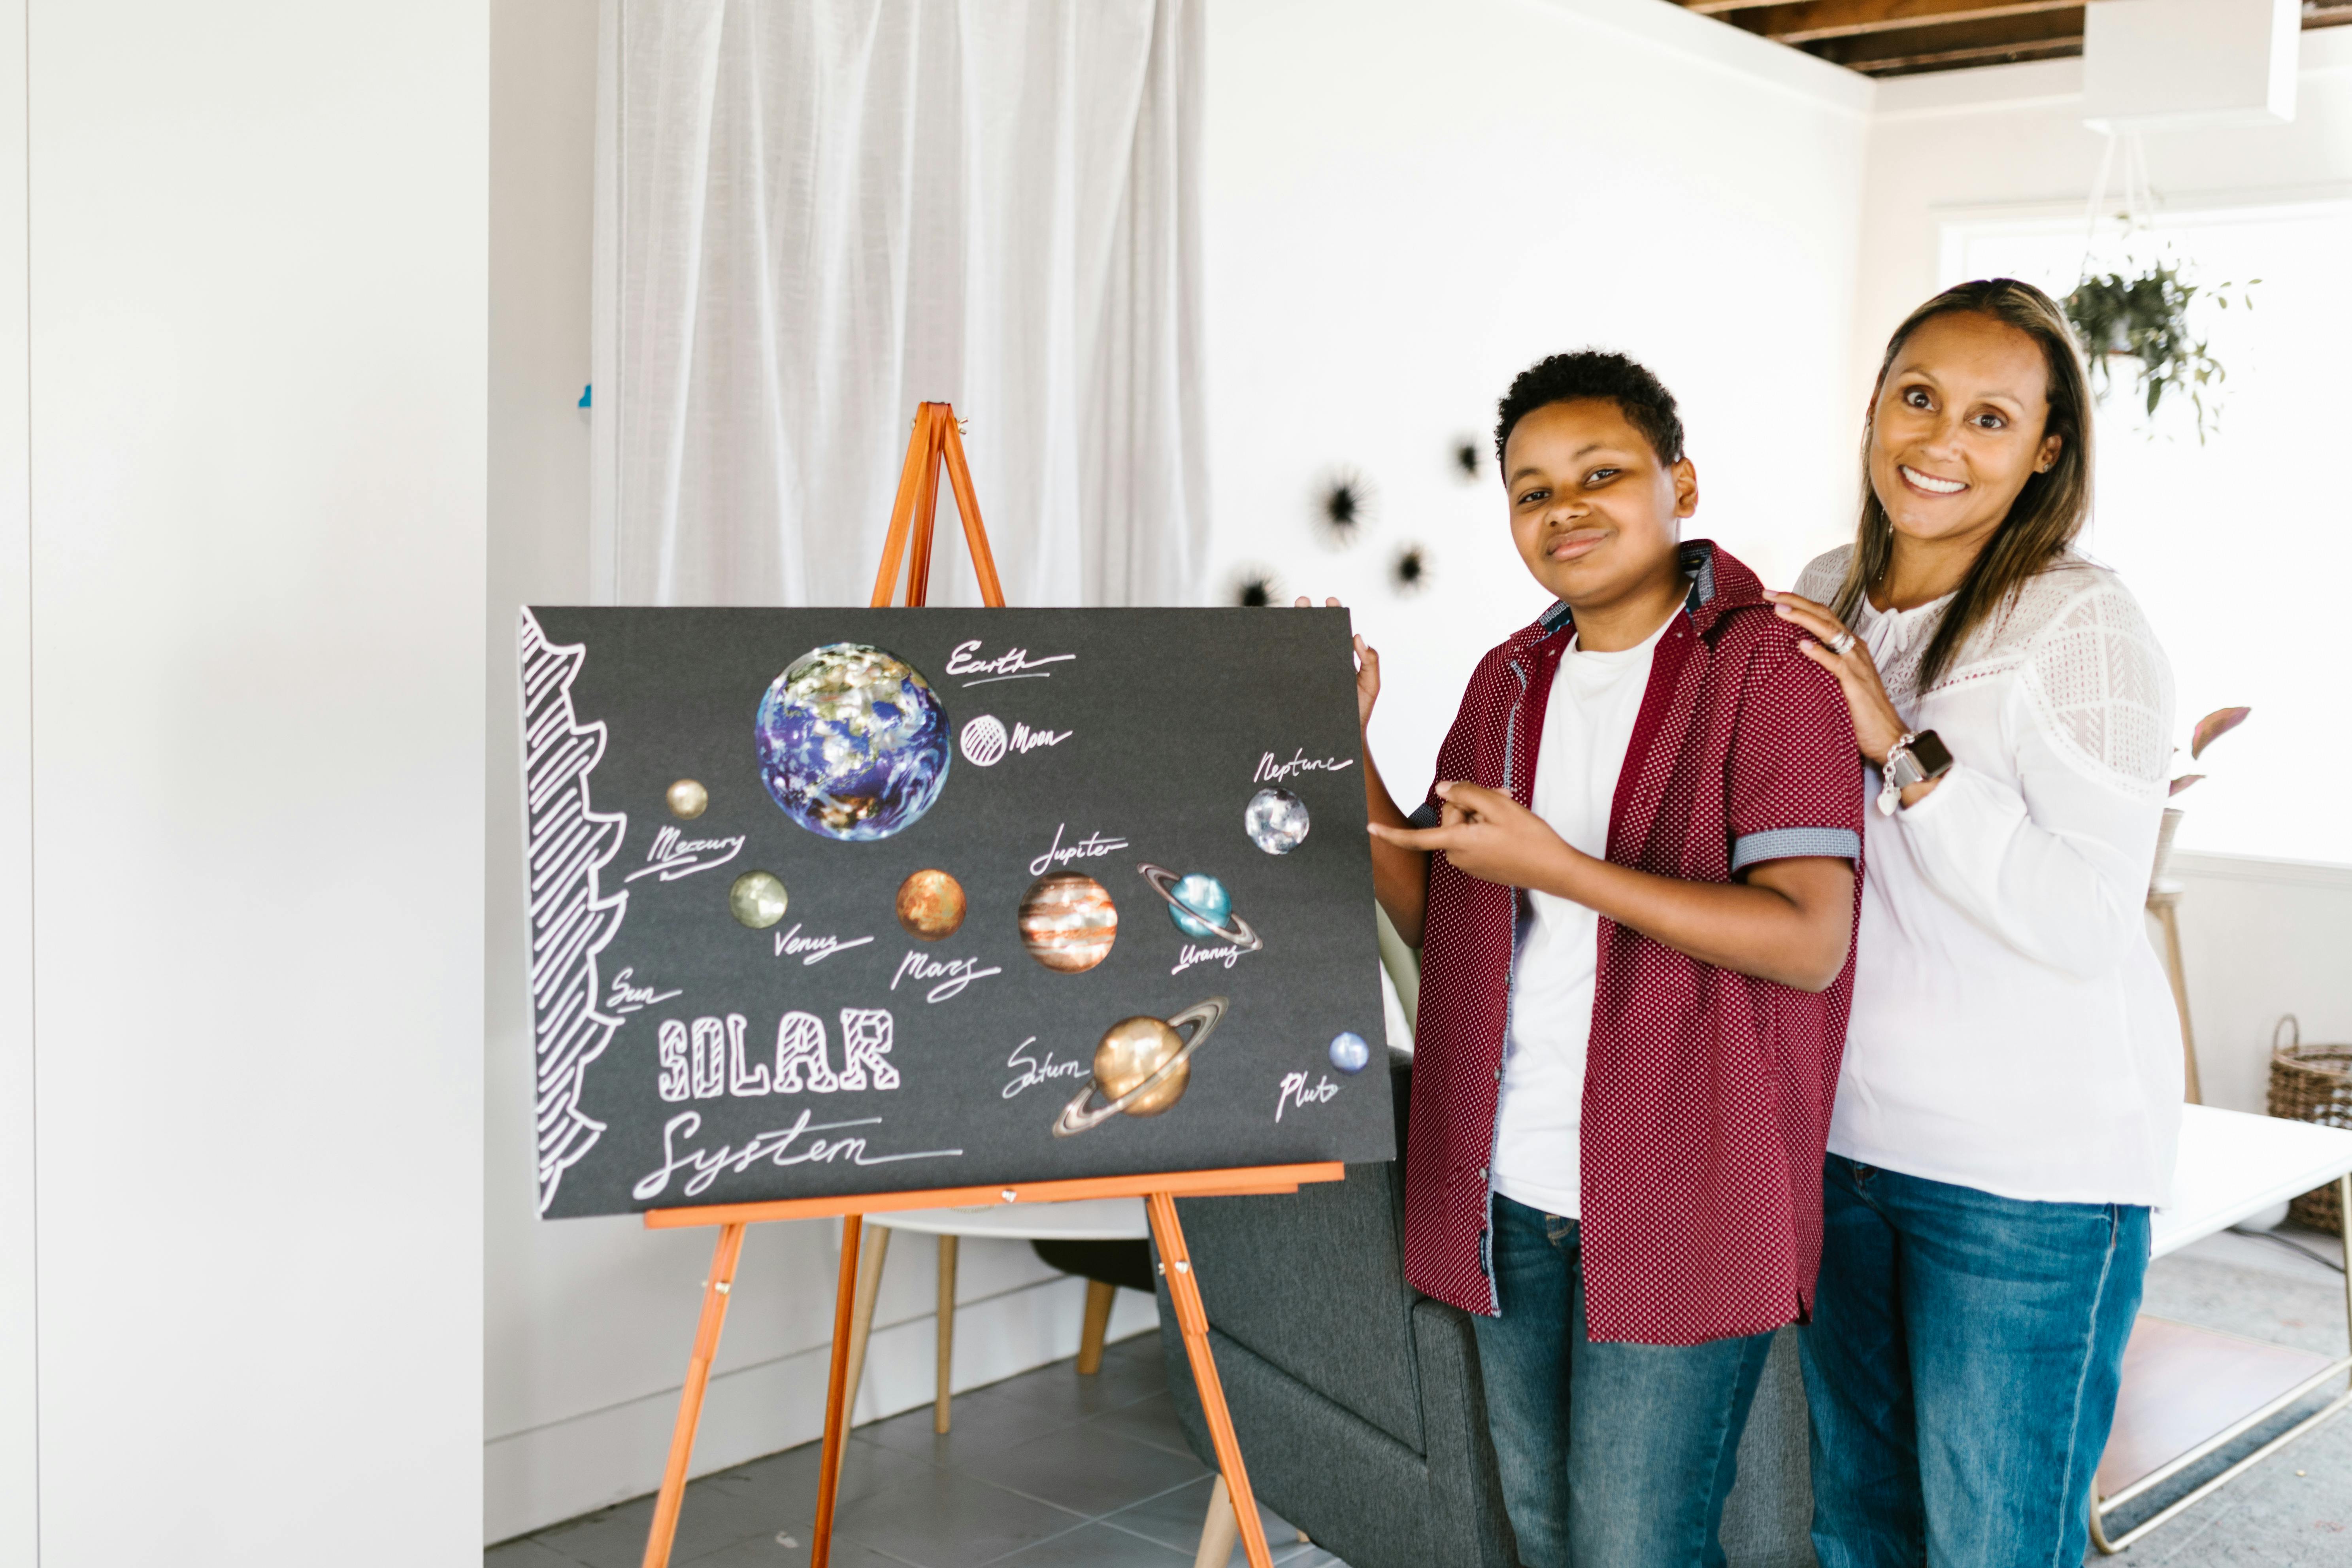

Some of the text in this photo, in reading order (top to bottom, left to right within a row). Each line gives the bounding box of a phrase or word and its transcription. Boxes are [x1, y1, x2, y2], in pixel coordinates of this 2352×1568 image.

[946, 640, 1076, 674] Earth
[1009, 722, 1073, 754] Moon
[1254, 747, 1353, 783] Neptune
[647, 825, 745, 881] Mercury
[1030, 823, 1128, 876] Jupiter
[774, 923, 874, 966] Venus
[1171, 945, 1255, 975] Uranus
[605, 966, 683, 1008] Sun
[890, 949, 1002, 1004] Mars
[658, 1007, 901, 1102] SOLAR
[1002, 1036, 1090, 1099] Saturn
[1275, 1071, 1341, 1123] Pluto
[632, 1108, 963, 1200] System
